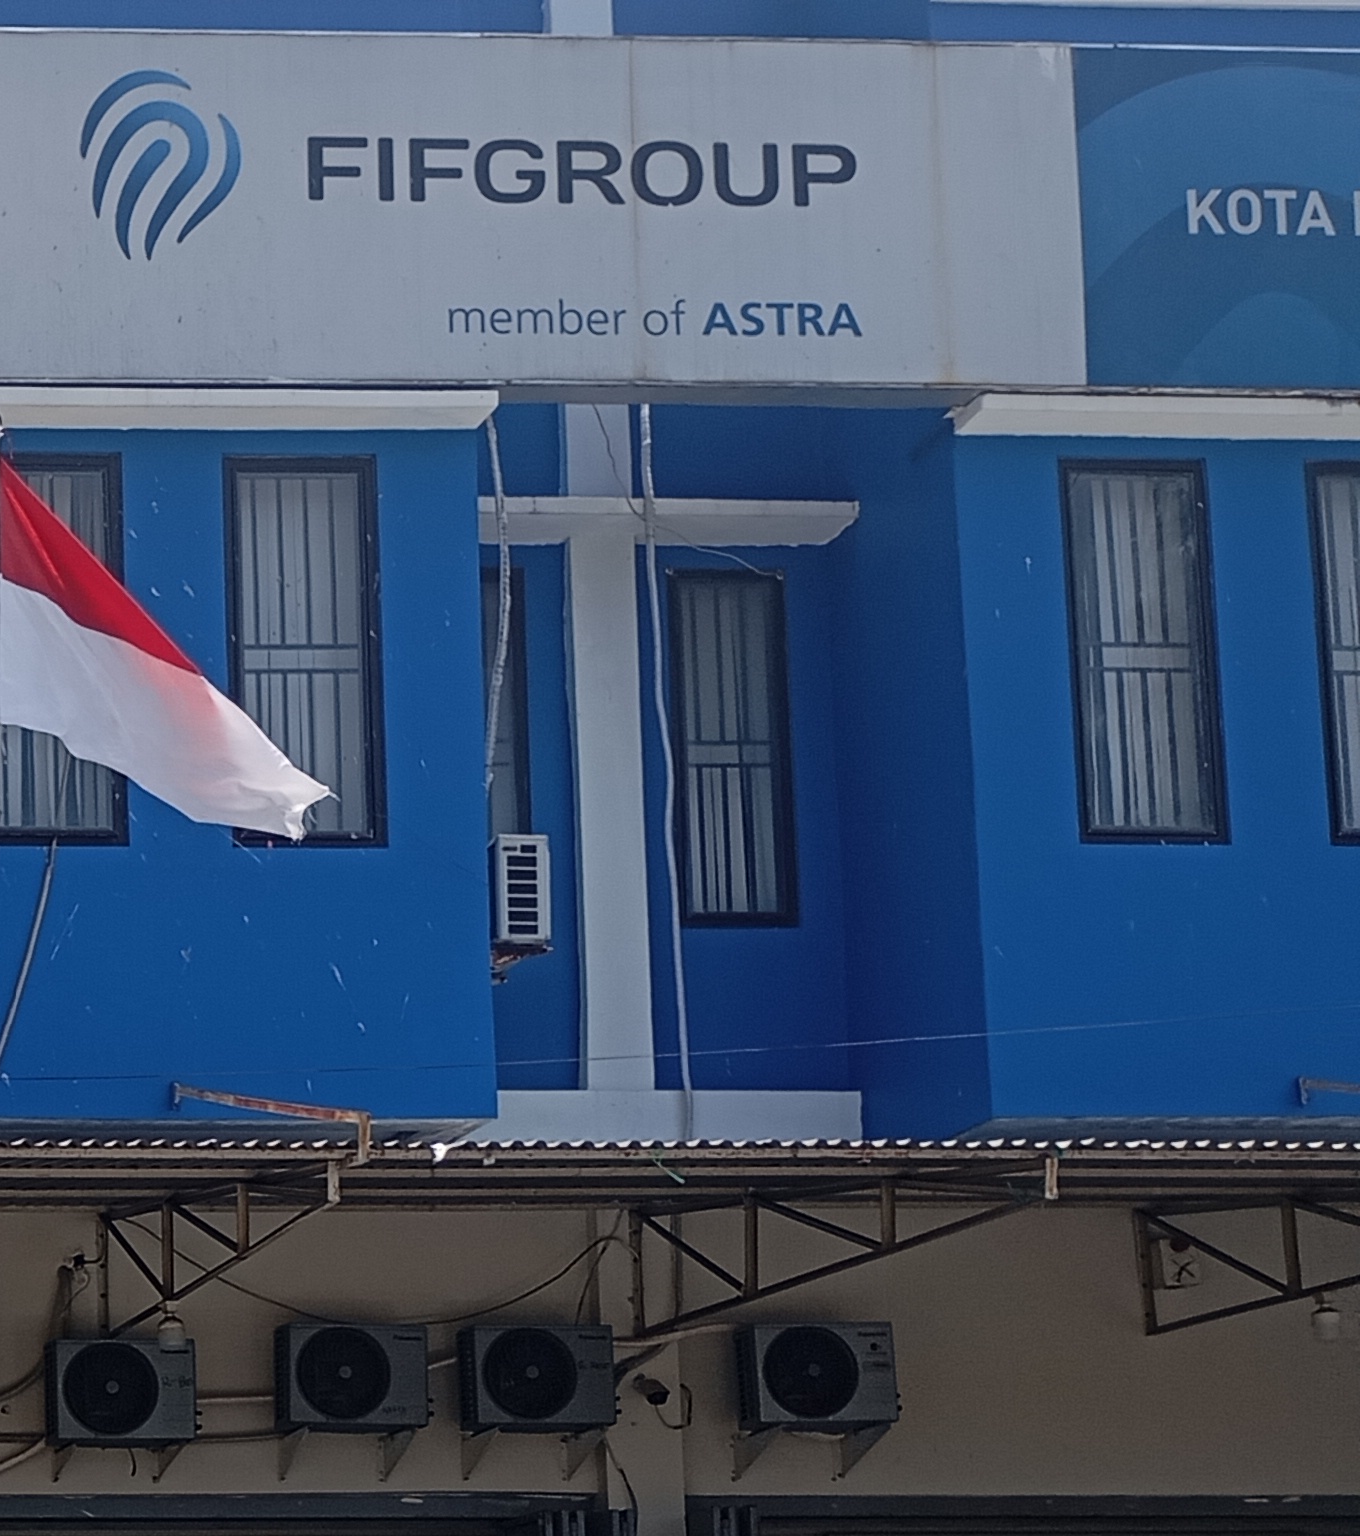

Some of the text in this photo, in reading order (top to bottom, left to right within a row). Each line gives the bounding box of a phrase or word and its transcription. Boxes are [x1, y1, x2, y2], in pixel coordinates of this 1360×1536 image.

[307, 136, 858, 207] FIFGROUP
[1185, 188, 1337, 237] KOTA
[447, 298, 862, 337] member of ASTRA
